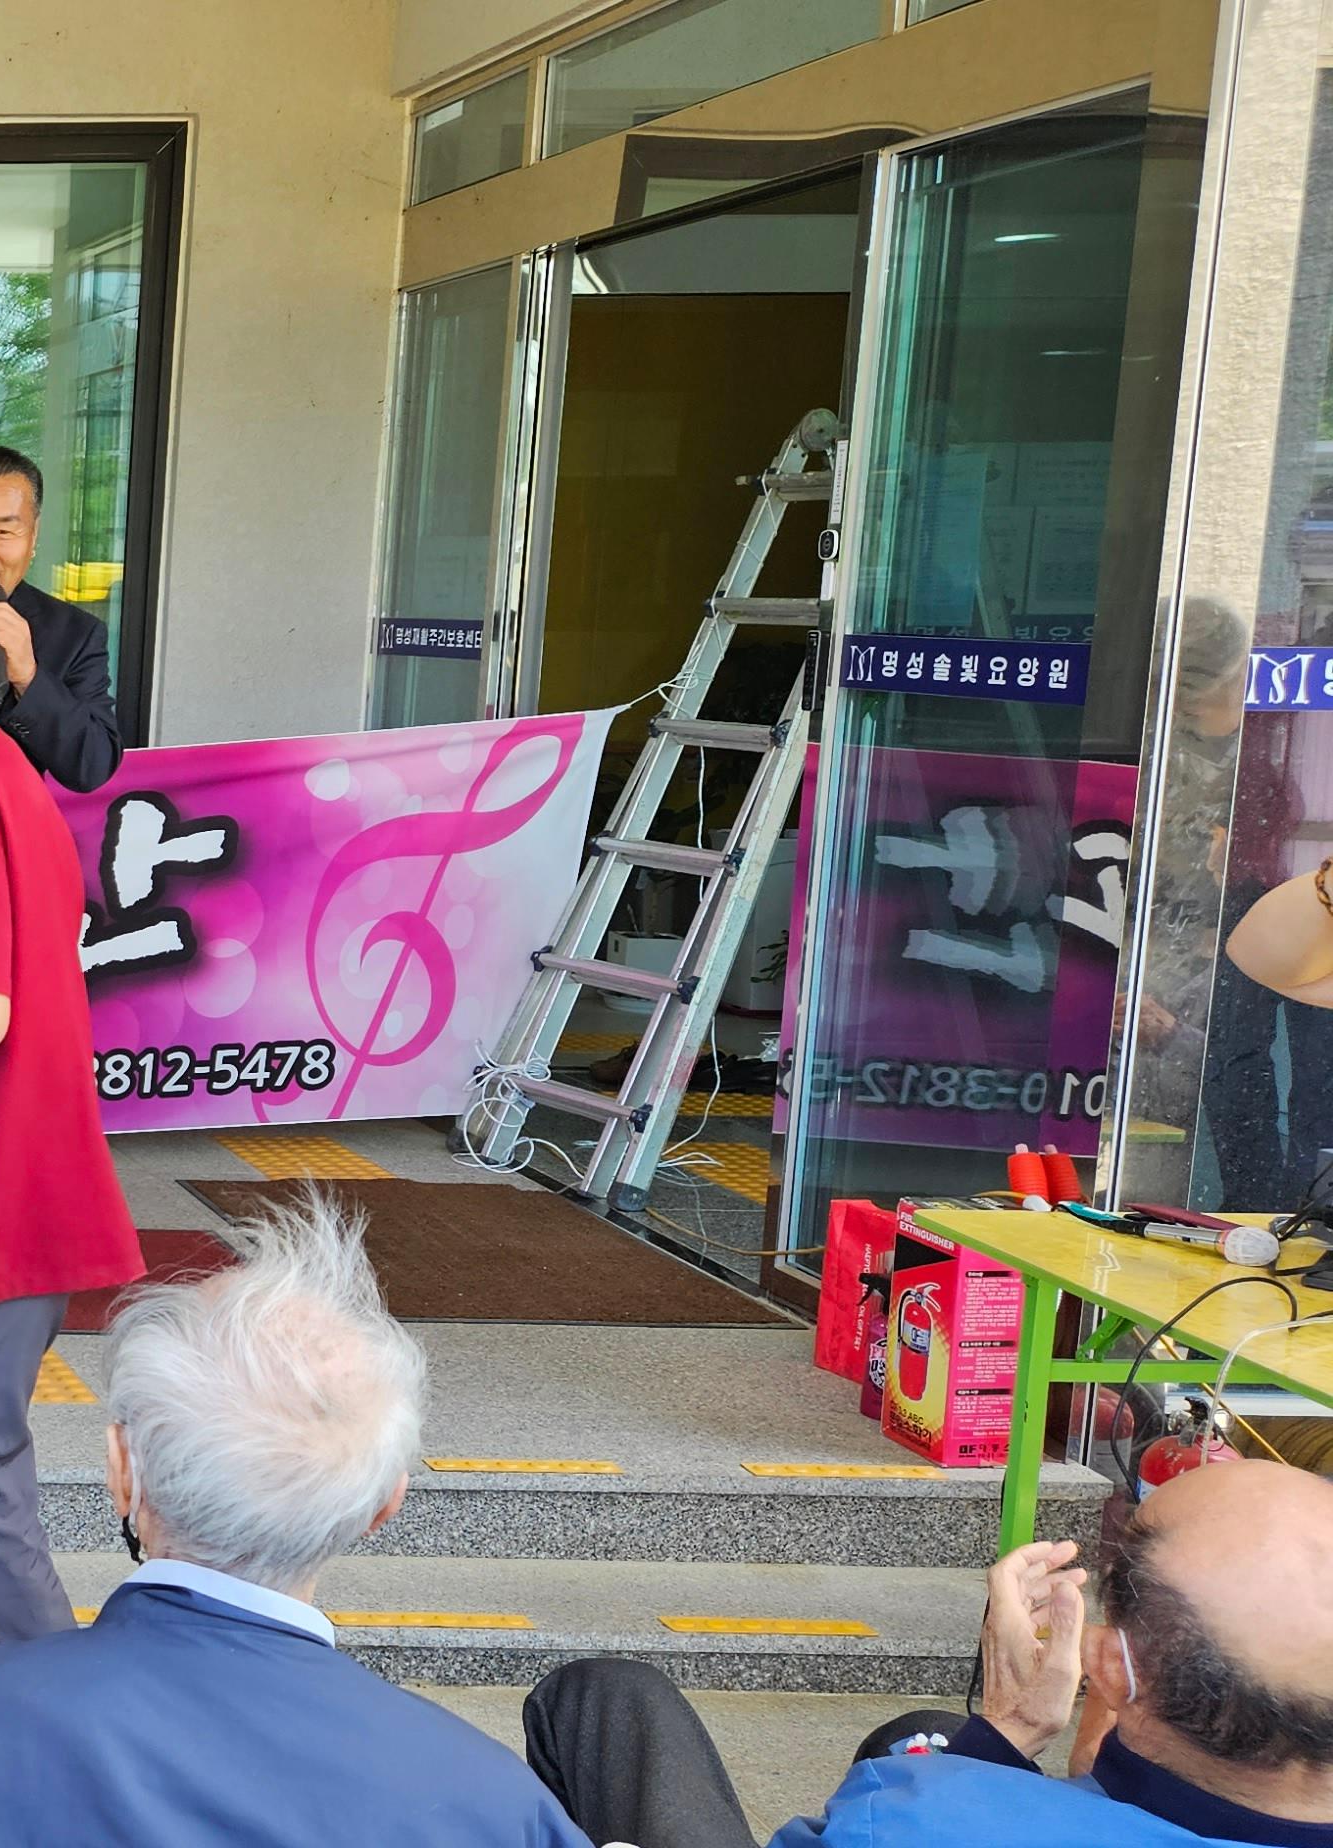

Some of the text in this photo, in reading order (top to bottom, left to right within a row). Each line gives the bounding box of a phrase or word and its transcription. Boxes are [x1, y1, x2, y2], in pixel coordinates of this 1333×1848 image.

[881, 650, 1071, 690] 명성솔빛요양원
[93, 1043, 332, 1097] 812-5478
[898, 1220, 956, 1252] EXTINGUISHER
